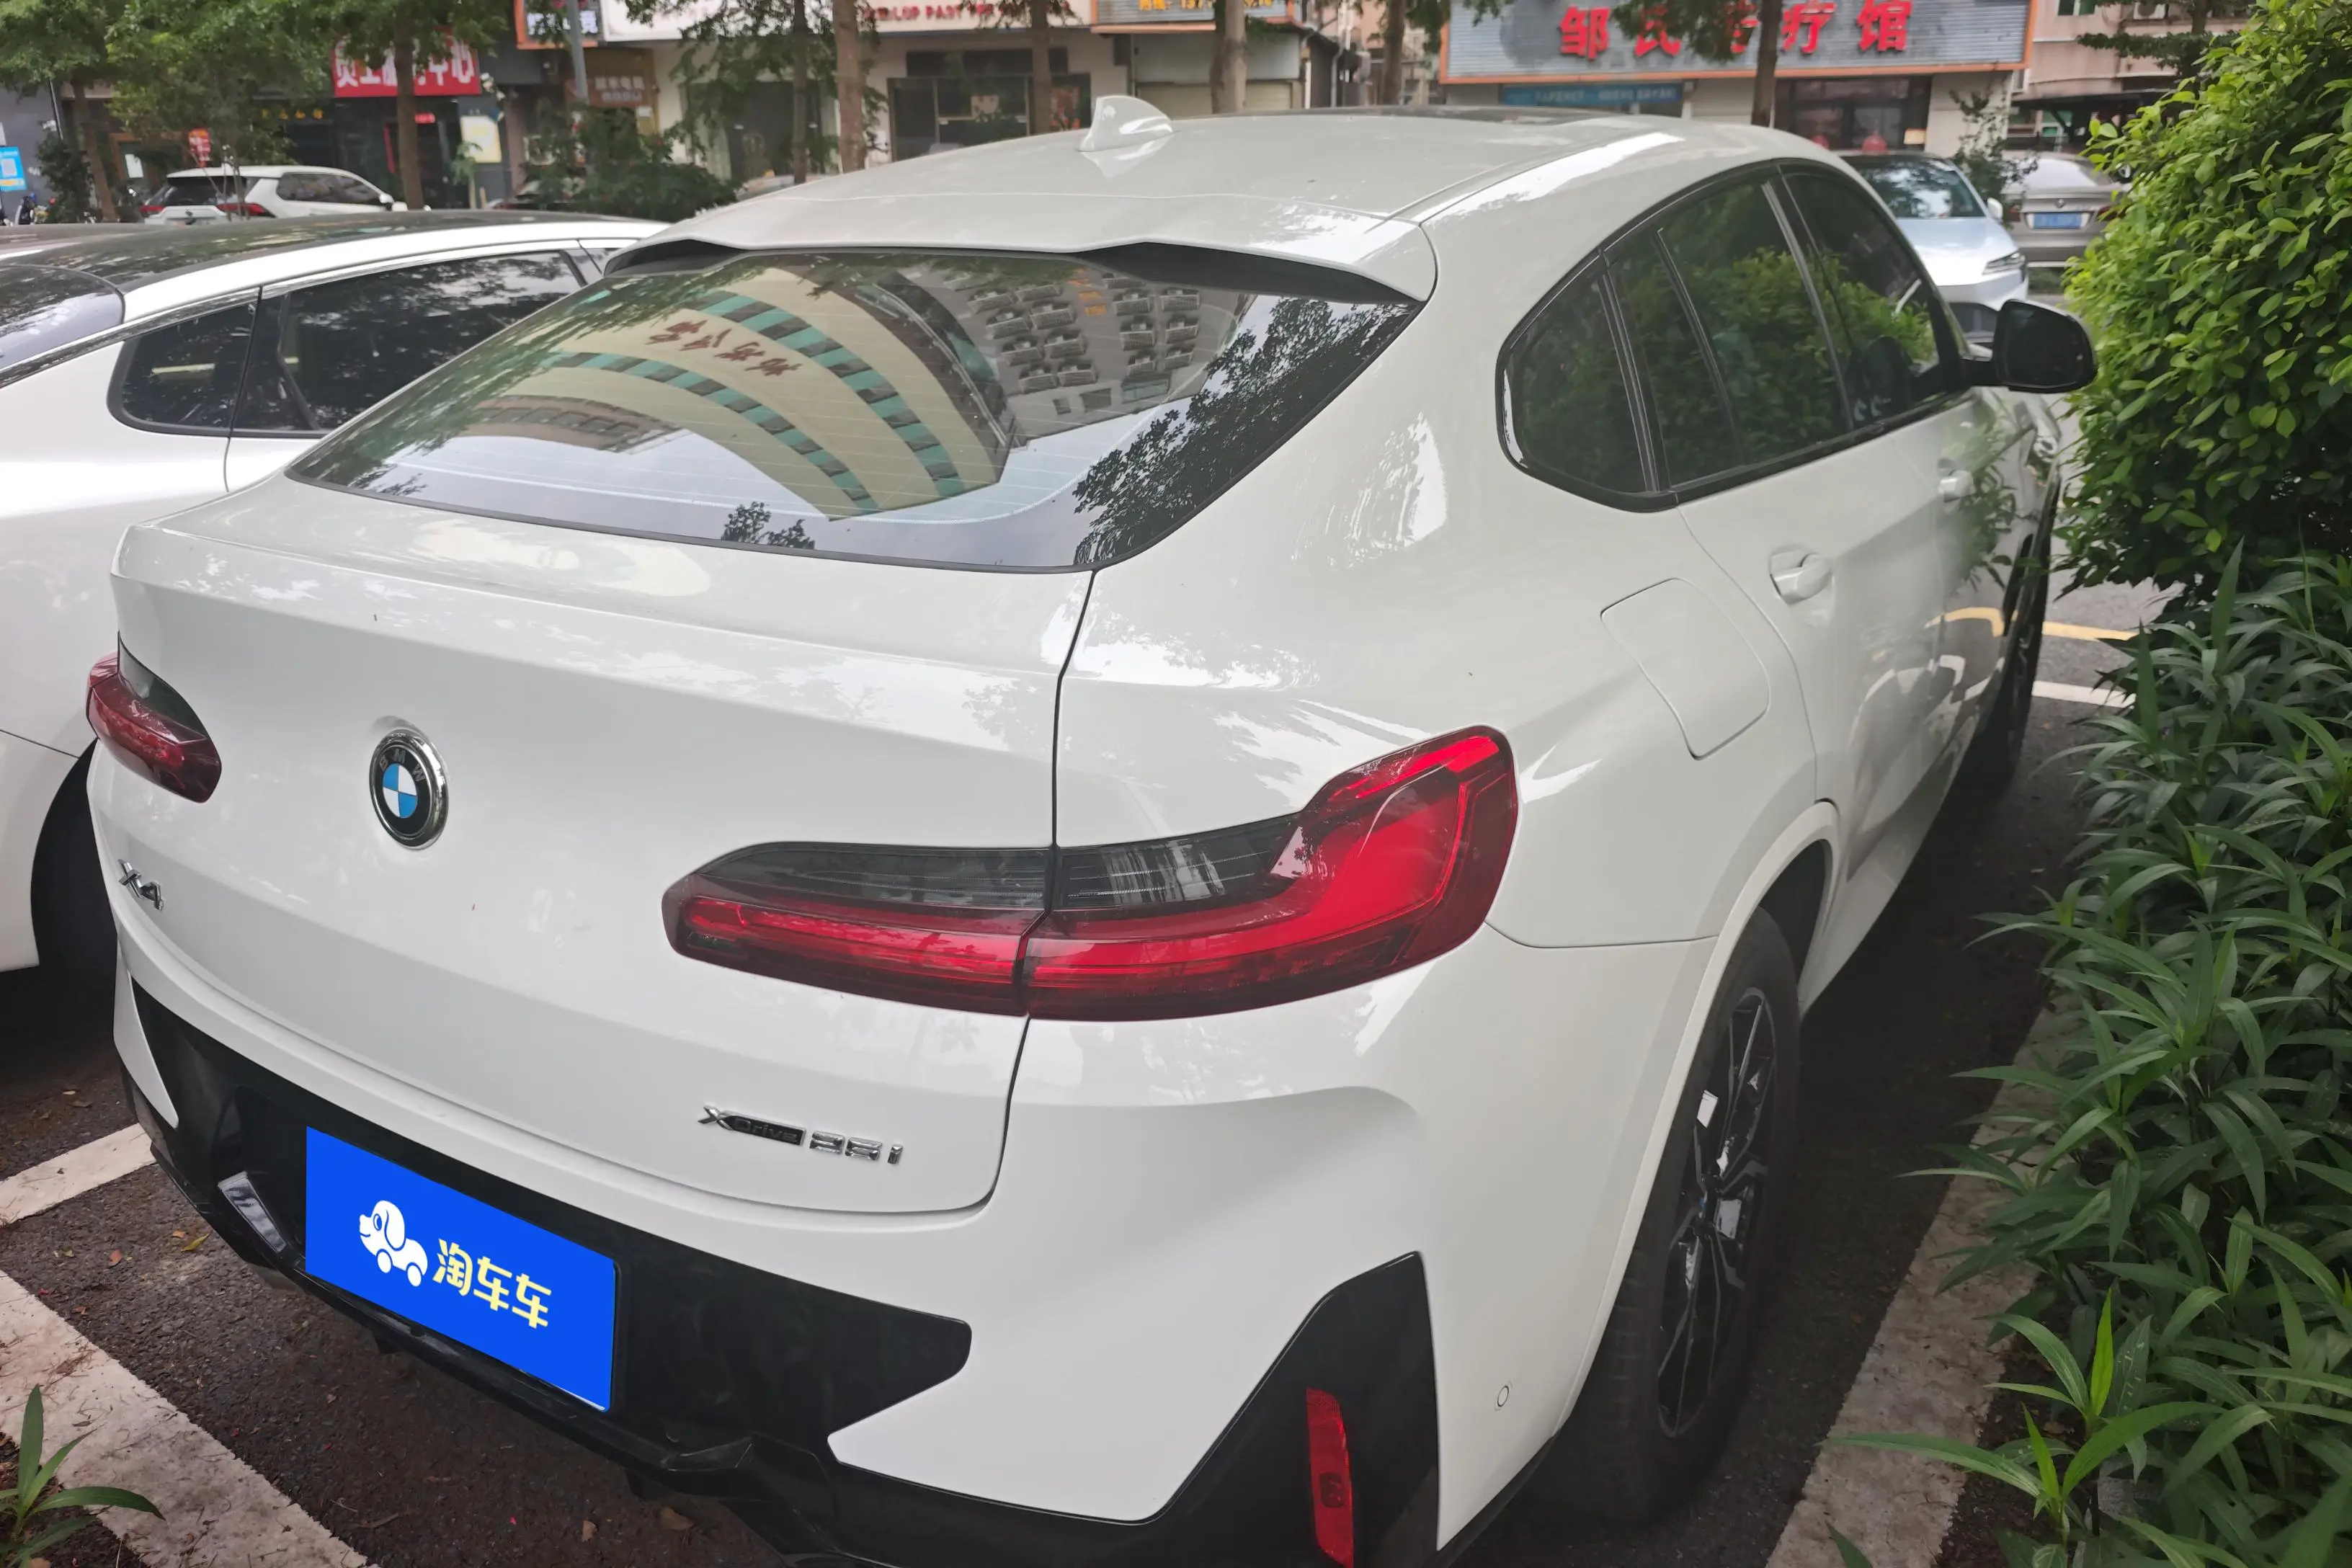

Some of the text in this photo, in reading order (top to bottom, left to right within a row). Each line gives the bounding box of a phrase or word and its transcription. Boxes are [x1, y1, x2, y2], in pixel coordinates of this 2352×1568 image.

[1559, 0, 1914, 60] 邹氏疗馆
[379, 748, 426, 782] BMW
[118, 859, 164, 912] X4
